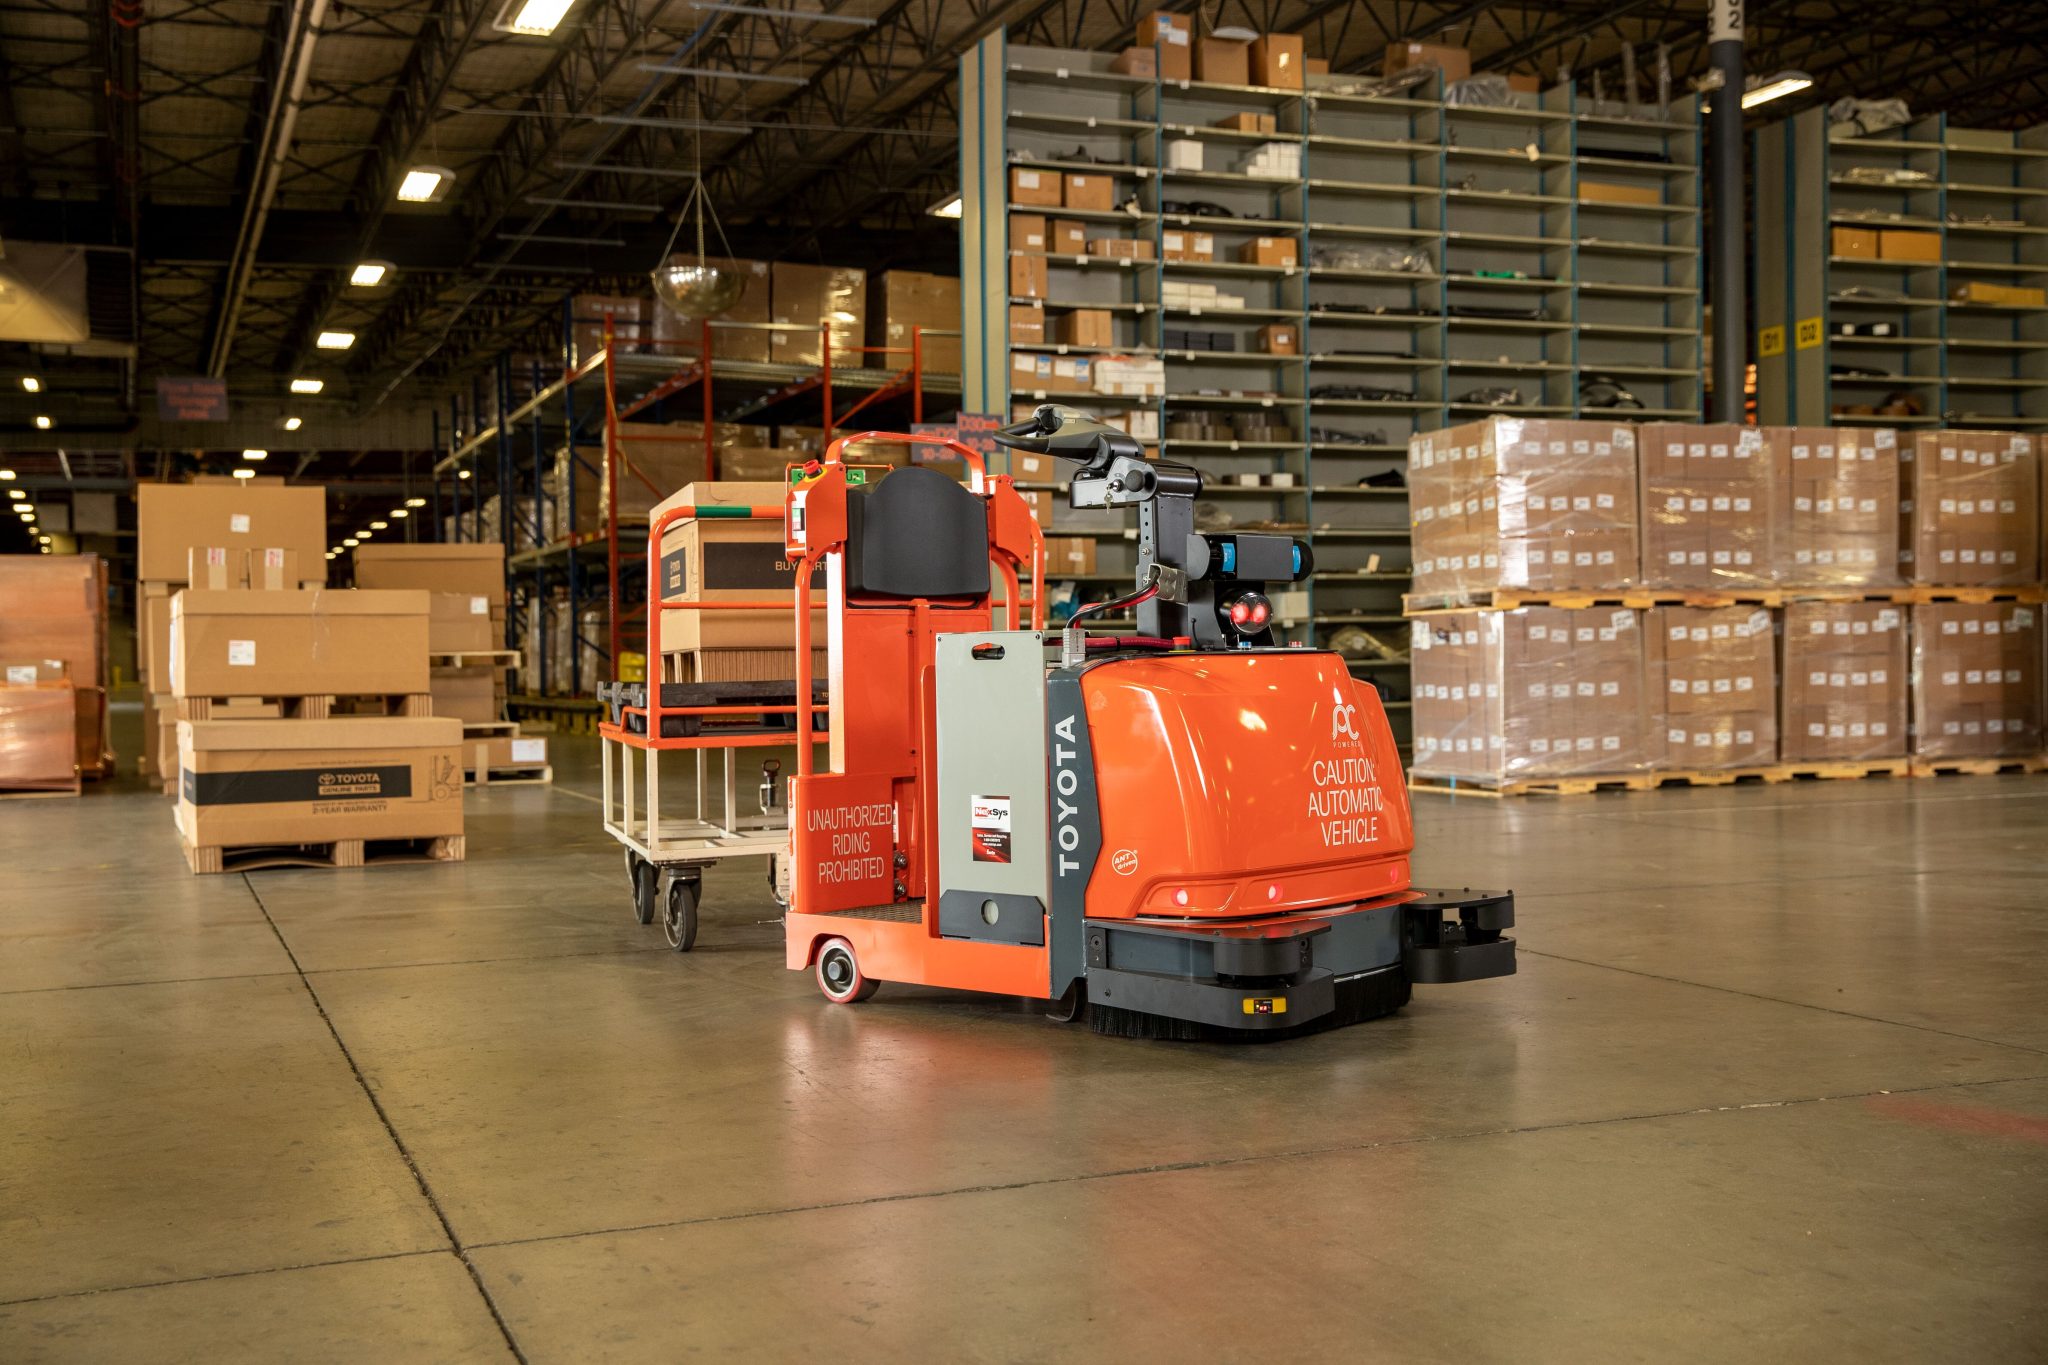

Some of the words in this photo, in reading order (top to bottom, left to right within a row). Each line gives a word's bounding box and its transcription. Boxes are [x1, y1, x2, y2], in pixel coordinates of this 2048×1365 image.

[775, 561, 798, 571] BUY
[336, 773, 381, 784] TOYOTA
[1313, 757, 1377, 787] CAUTION:
[343, 803, 388, 813] WARRANTY
[1055, 714, 1080, 877] TOYOTA
[1308, 786, 1384, 817] AUTOMATIC
[807, 803, 893, 832] UNAUTHORIZED
[975, 807, 1008, 820] NexSys
[832, 831, 871, 856] RIDING
[1321, 816, 1379, 847] VEHICLE
[818, 856, 885, 885] PROHIBITED
[1114, 853, 1131, 864] ANT
[1117, 859, 1136, 870] driven
